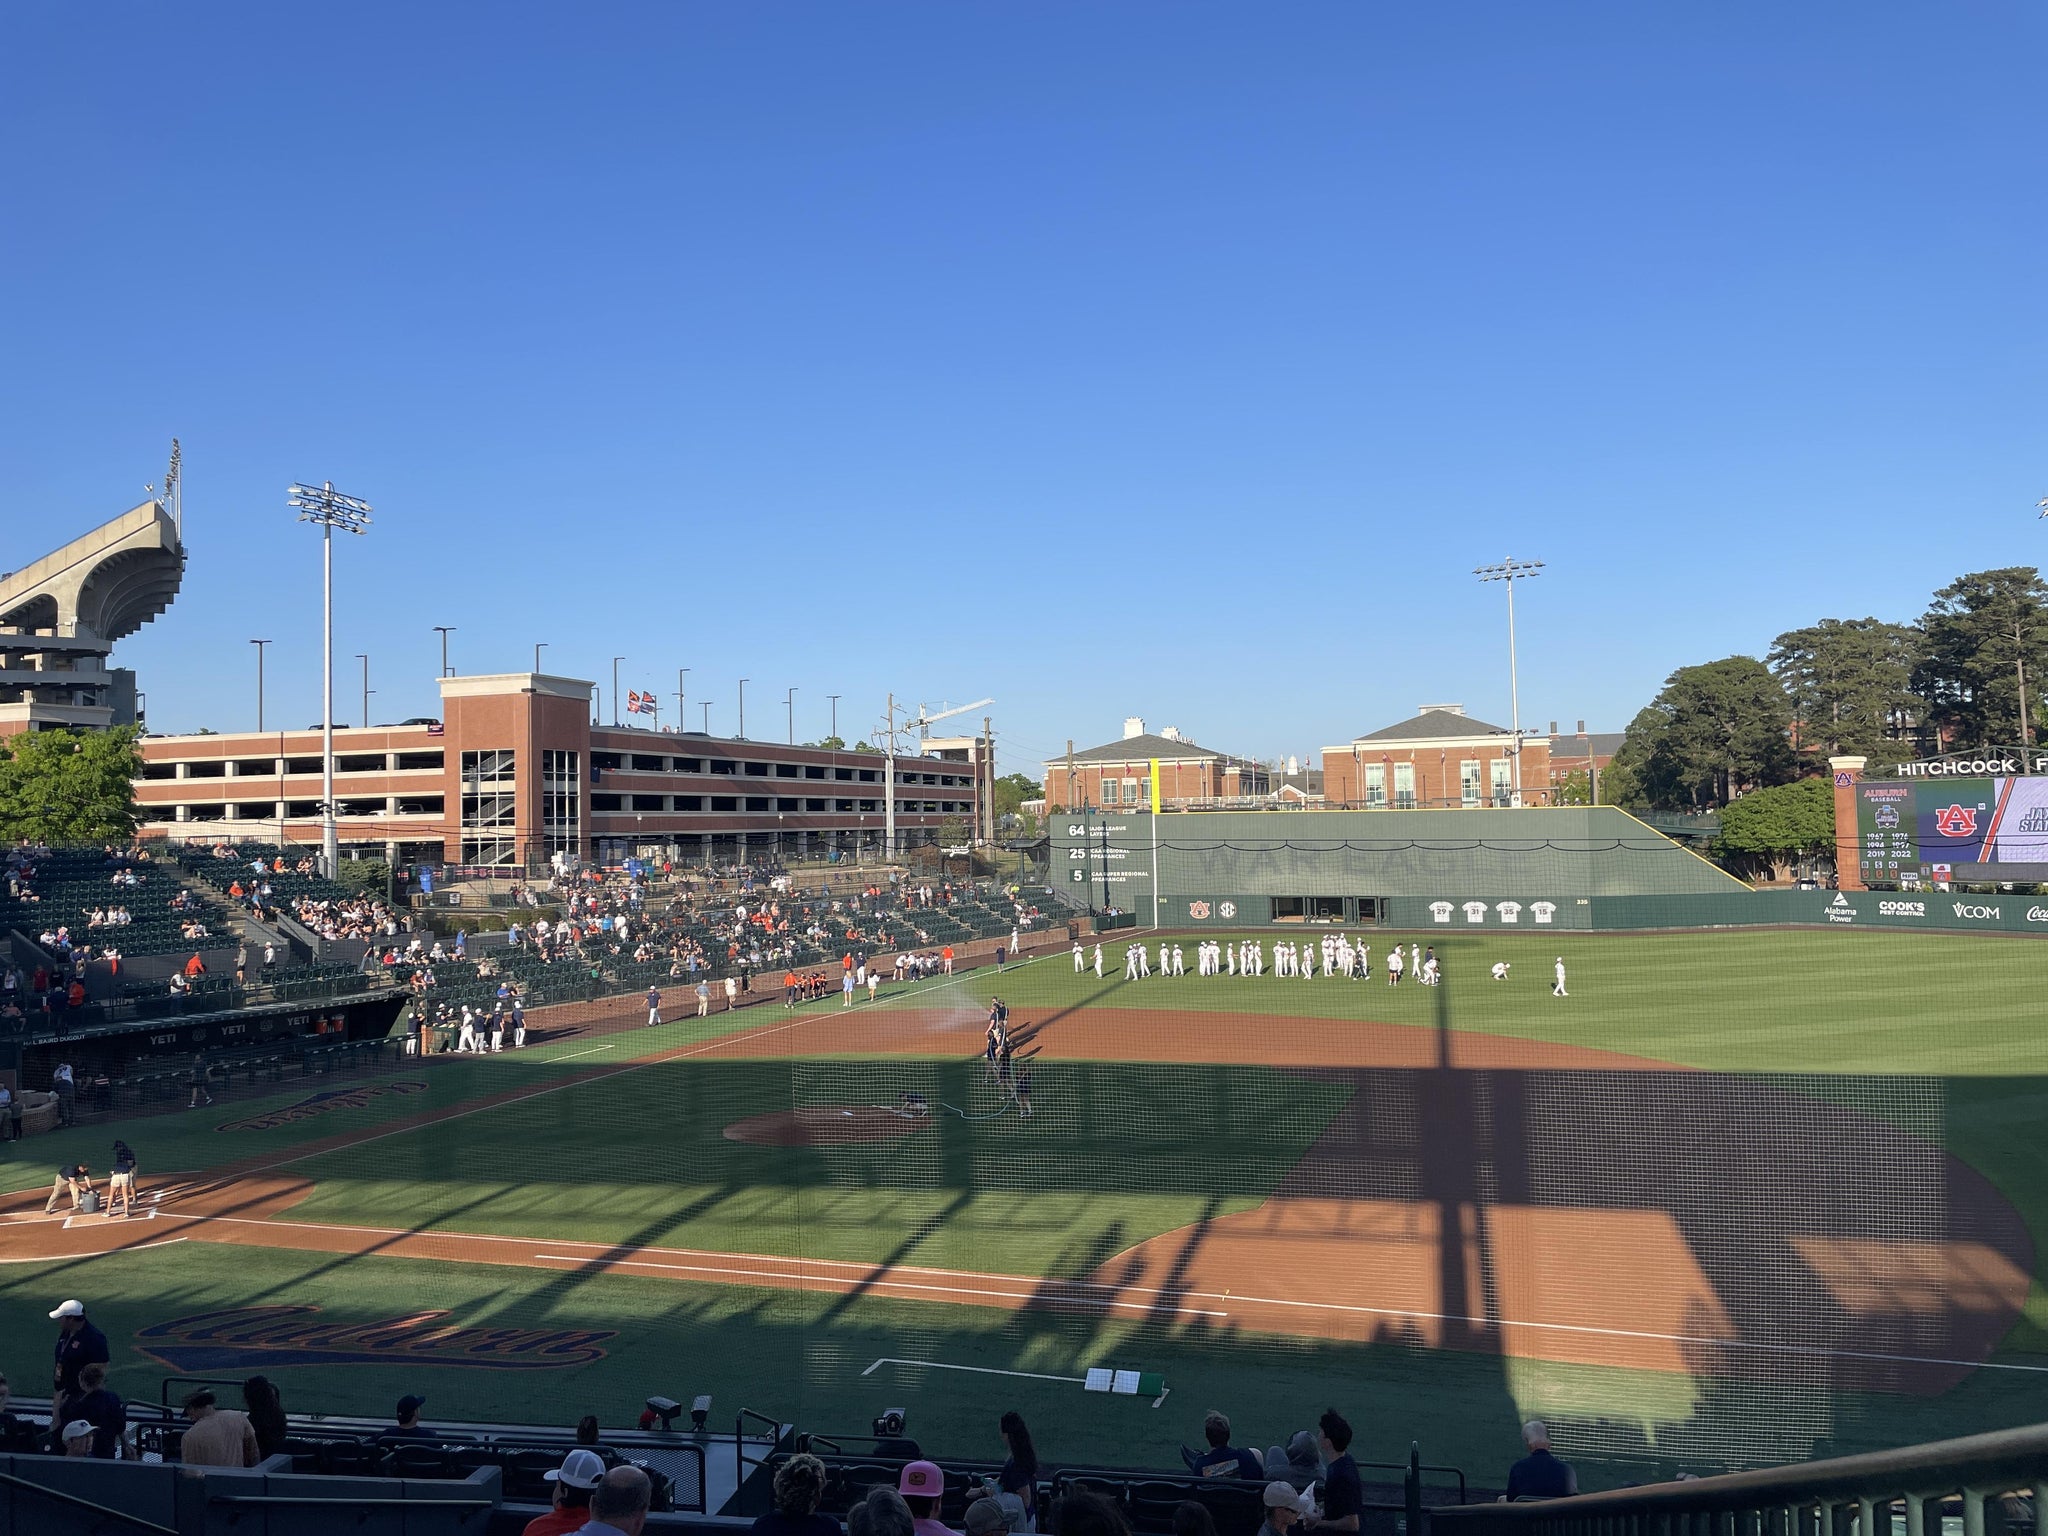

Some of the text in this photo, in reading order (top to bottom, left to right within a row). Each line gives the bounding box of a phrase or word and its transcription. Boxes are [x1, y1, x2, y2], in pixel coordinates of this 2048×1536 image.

[1898, 759, 2016, 776] HITCHCOCK
[1864, 788, 1907, 797] AUBURN
[1069, 825, 1086, 836] 64
[1069, 848, 1086, 859] 25
[1867, 850, 1912, 858] 2019 2022
[1073, 870, 1083, 881] 5
[1220, 902, 1235, 918] SEC
[1824, 907, 1857, 915] Alabama
[1879, 901, 1925, 911] COOK'S
[1952, 902, 2000, 919] VCOM
[287, 1016, 309, 1026] YETI
[222, 1025, 245, 1036] YETI
[23, 1034, 85, 1046] HAL BAIRD DUGOUT
[151, 1034, 176, 1045] YETI
